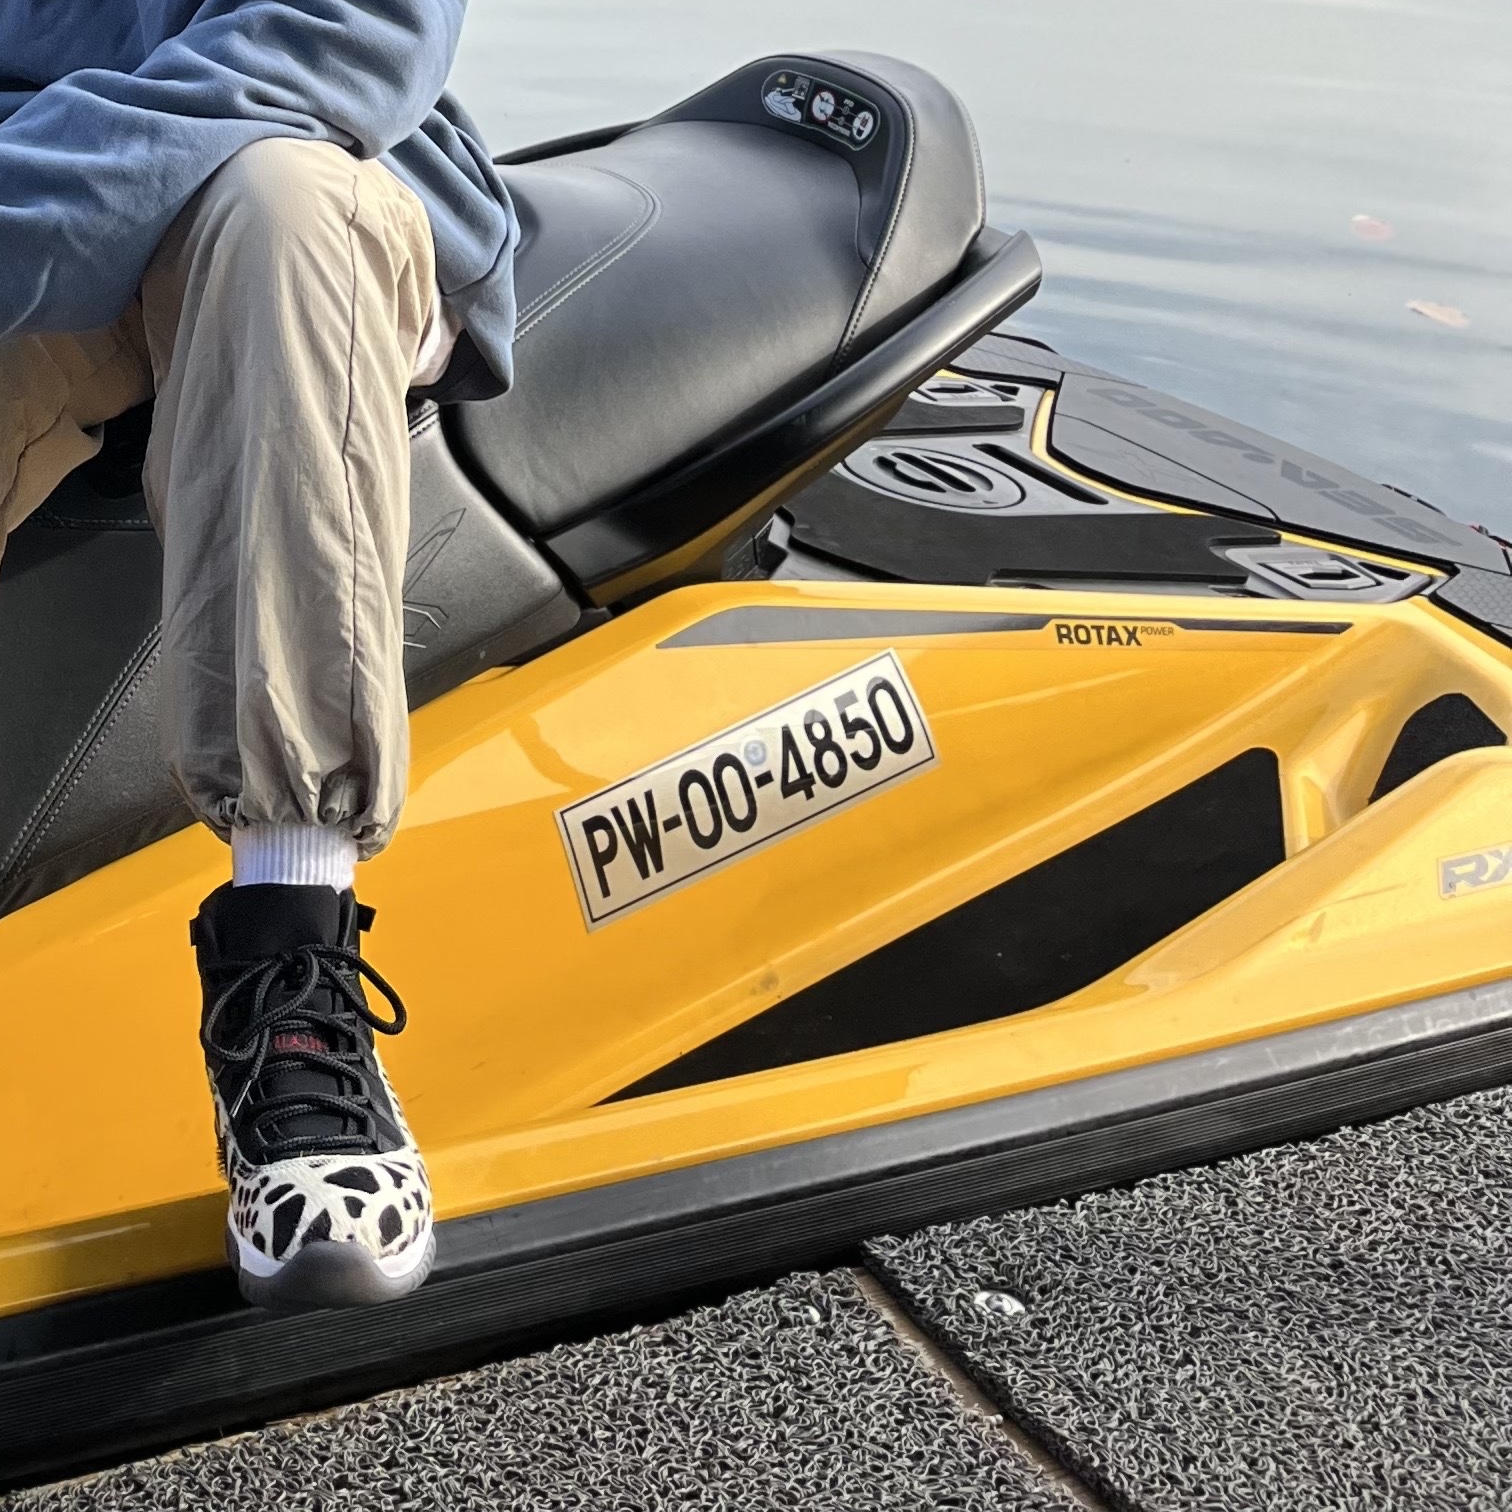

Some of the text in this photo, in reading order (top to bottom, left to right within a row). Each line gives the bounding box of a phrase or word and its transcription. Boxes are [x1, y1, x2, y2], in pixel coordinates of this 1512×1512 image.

[1055, 624, 1175, 646] ROTAX POWER
[582, 676, 914, 899] PW-00-4850
